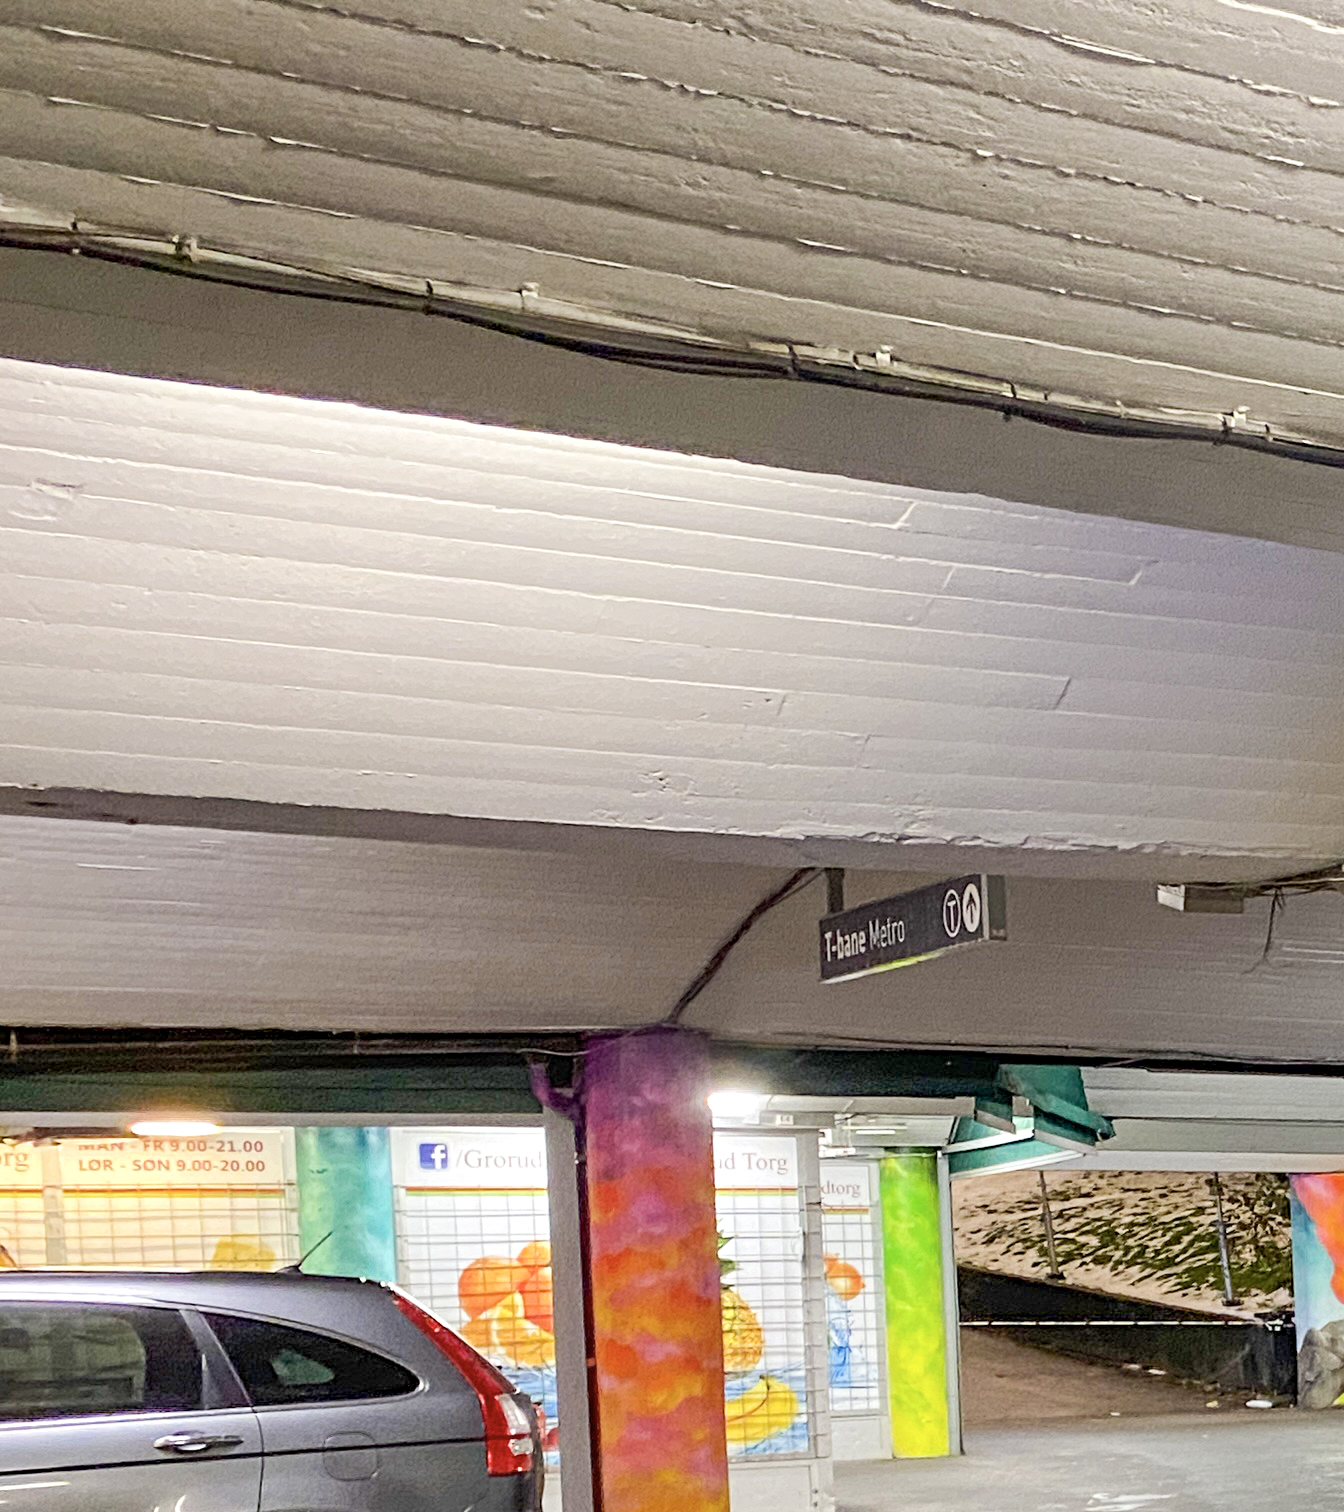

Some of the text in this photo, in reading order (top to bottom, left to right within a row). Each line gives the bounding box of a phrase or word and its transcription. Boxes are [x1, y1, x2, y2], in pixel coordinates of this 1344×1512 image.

[824, 917, 905, 962] T-bane Metro
[143, 1140, 165, 1152] FR
[176, 1159, 266, 1173] 9.00-20.00
[742, 1152, 788, 1175] Torg
